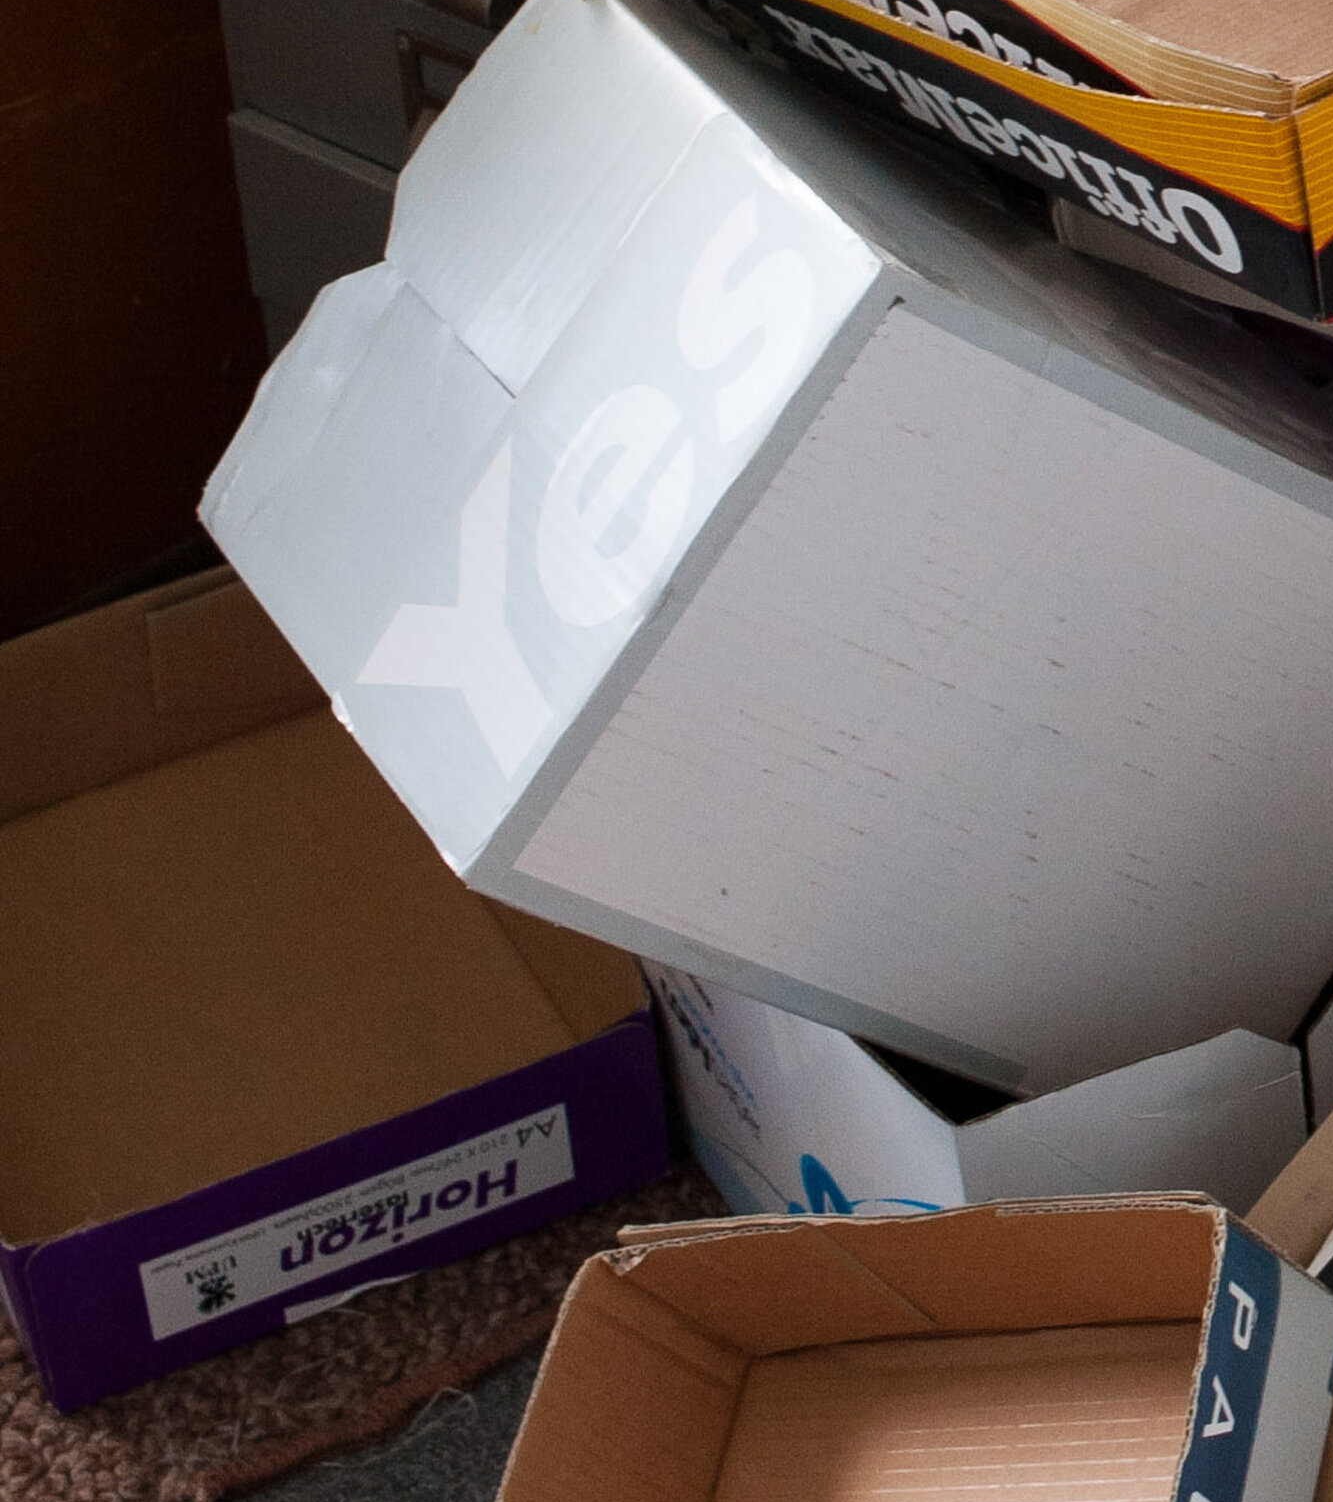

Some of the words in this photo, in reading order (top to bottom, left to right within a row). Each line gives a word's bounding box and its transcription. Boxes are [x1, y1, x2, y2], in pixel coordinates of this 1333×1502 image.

[355, 192, 816, 782] Yes
[516, 1115, 556, 1147] A4
[281, 1162, 529, 1270] Horizon
[292, 1187, 413, 1240] lasertech
